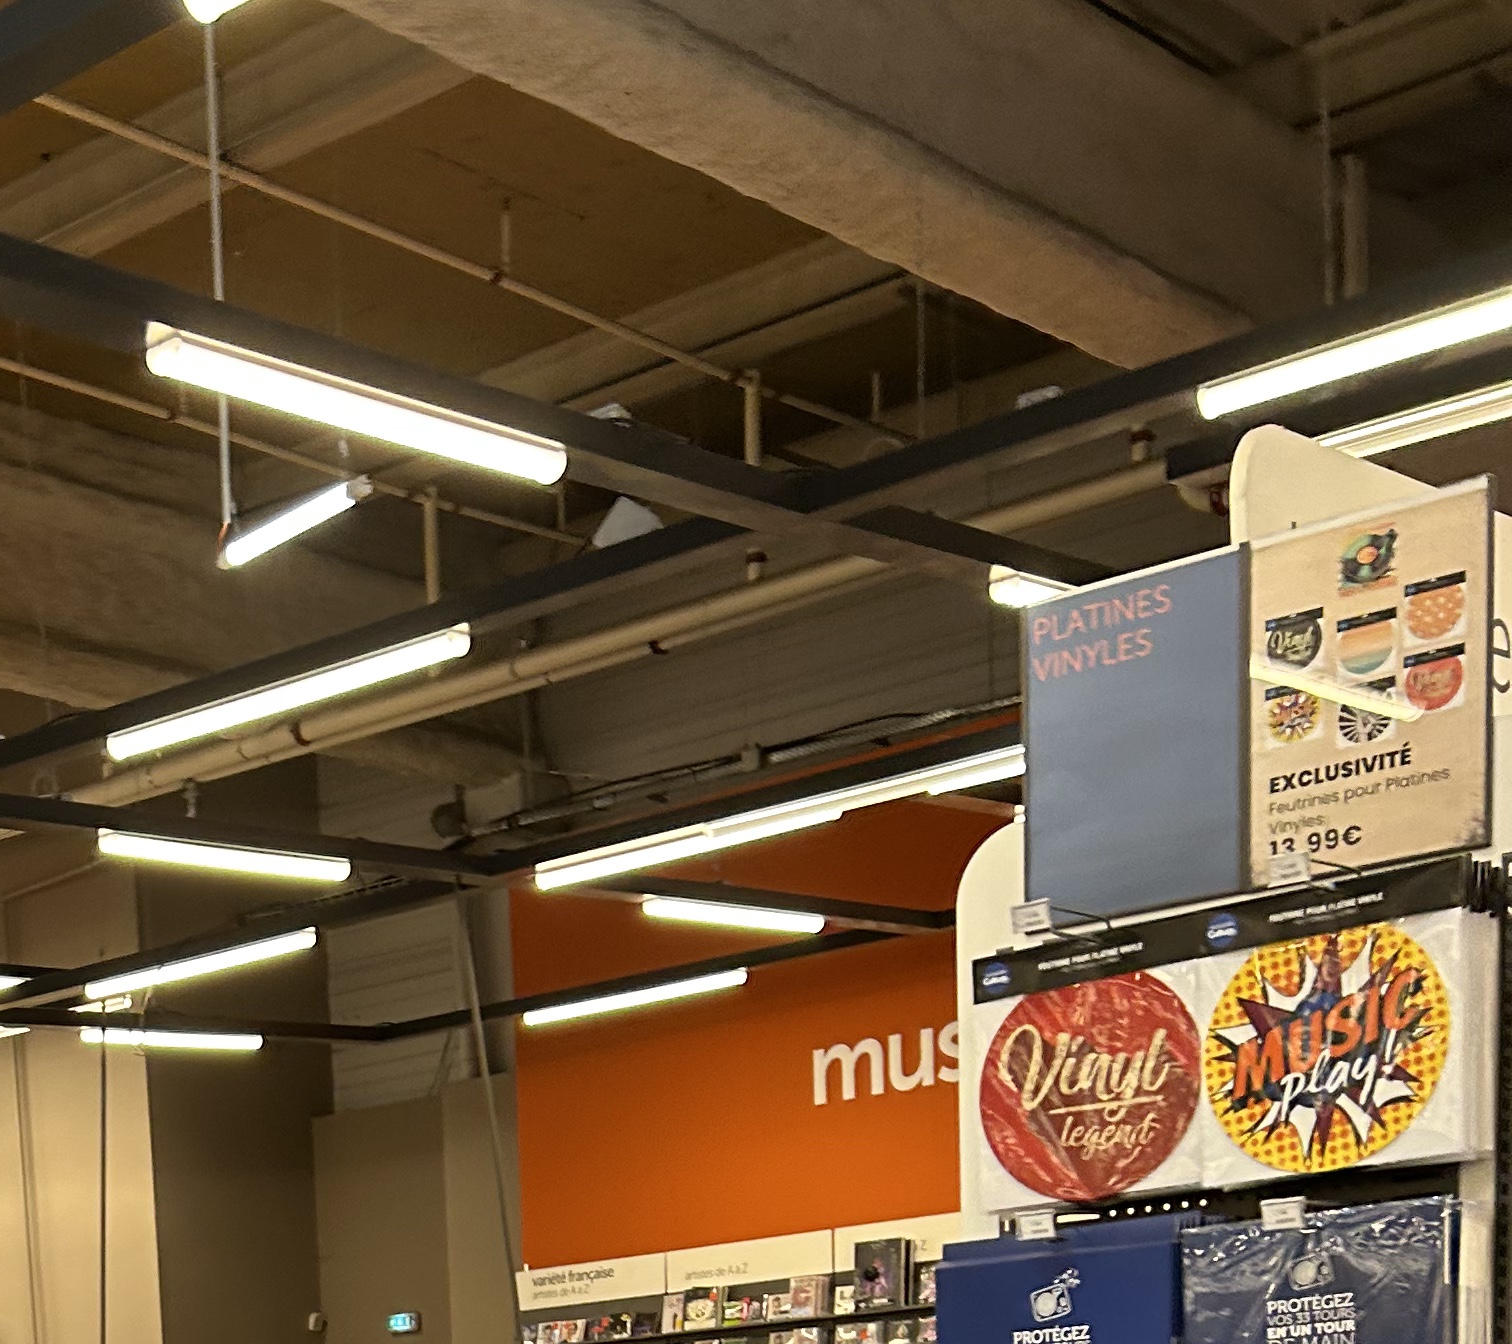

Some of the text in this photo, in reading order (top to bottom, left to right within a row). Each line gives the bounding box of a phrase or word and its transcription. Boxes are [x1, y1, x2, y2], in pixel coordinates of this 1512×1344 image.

[1033, 584, 1172, 646] PLATINES
[1033, 628, 1154, 682] VINYLES
[1269, 742, 1413, 794] EXCLUSIVITÉ
[1269, 767, 1450, 815] Feutrines pour Platines
[1269, 814, 1326, 835] Vinyles
[1233, 967, 1424, 1101] MUSIC
[999, 1023, 1179, 1122] Vinyl
[1280, 1032, 1398, 1120] play!
[1060, 1110, 1160, 1159] legend
[1266, 1292, 1354, 1314] PROTÉGEZ
[1266, 1307, 1356, 1326] VOS 33 TOURS
[1013, 1325, 1090, 1344] PROTÉGEZ
[1266, 1320, 1356, 1339] EN UN TOUR
